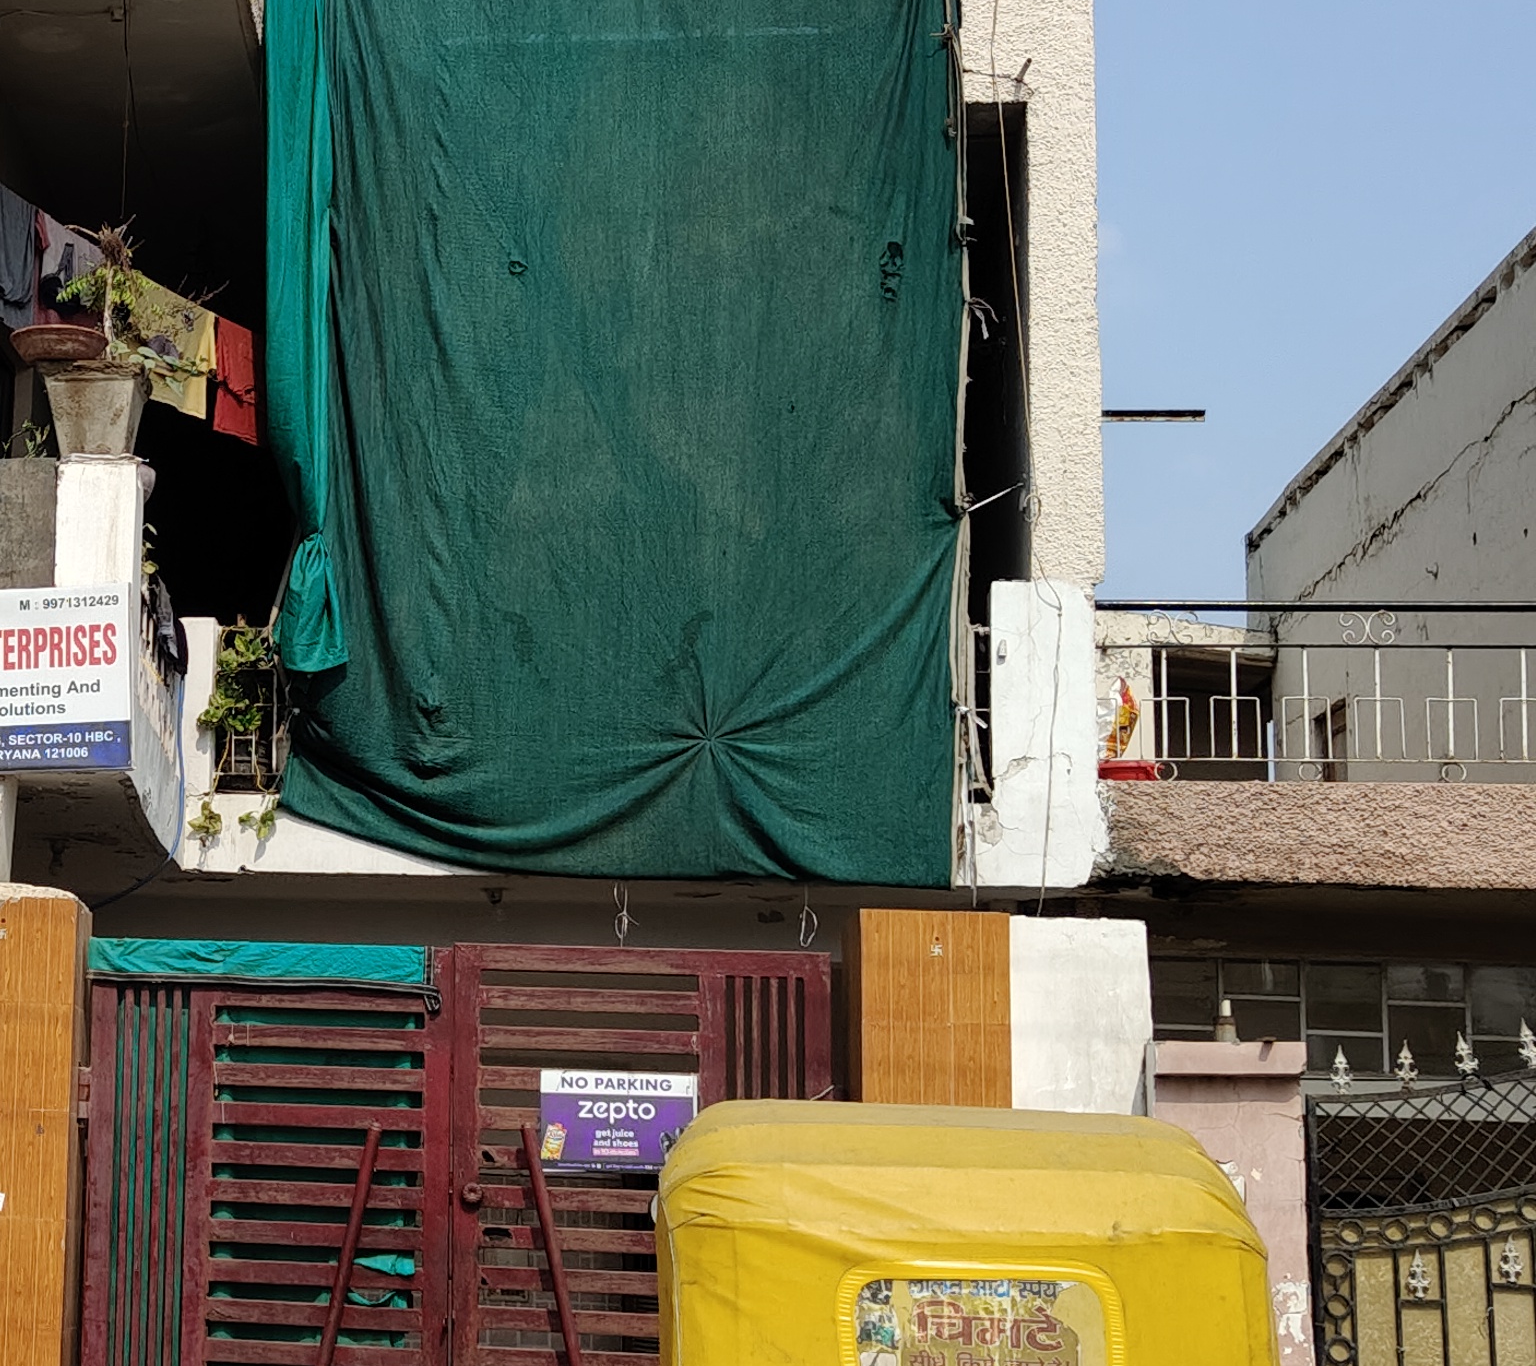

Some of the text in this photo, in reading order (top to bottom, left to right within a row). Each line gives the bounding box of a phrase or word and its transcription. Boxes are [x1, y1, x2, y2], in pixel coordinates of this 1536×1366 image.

[19, 599, 31, 611] M
[42, 594, 120, 610] 9971312429
[66, 679, 101, 694] And
[8, 732, 82, 746] SECTOR-10
[85, 730, 114, 743] HBC
[44, 746, 89, 759] 121006
[561, 1076, 672, 1092] NO PARKING
[578, 1099, 656, 1125] zepto
[595, 1128, 635, 1140] get juice
[593, 1139, 639, 1148] and shoes
[913, 1300, 1063, 1351] चिमटे
